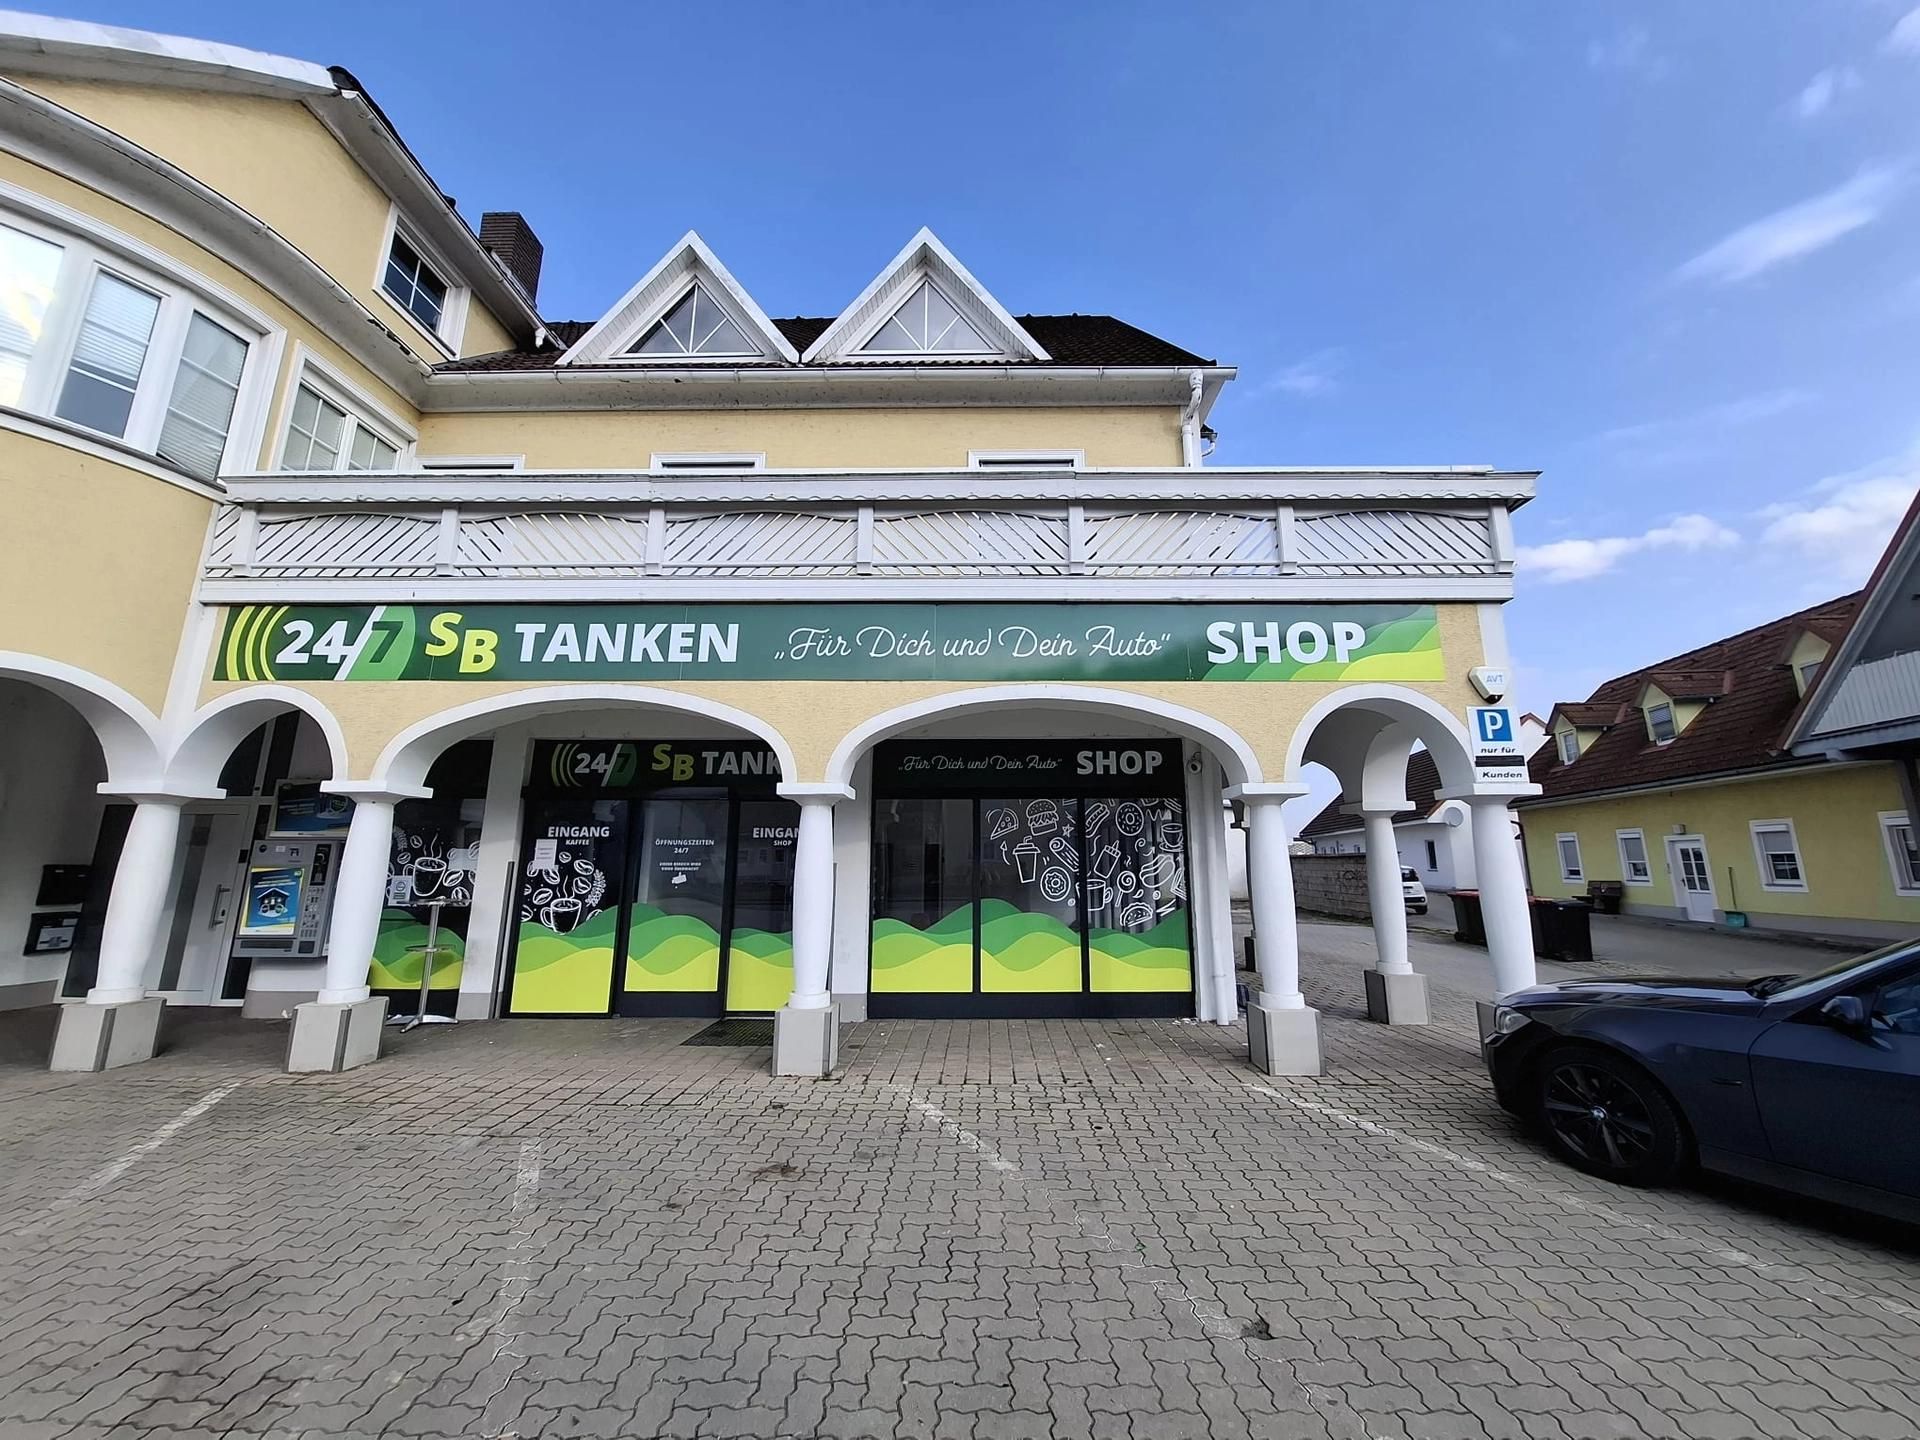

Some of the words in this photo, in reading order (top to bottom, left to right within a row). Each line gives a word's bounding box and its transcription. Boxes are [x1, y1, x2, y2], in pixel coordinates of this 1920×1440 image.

[275, 606, 403, 680] 24/7
[425, 612, 498, 673] SB
[515, 623, 739, 663] TANKEN
[856, 626, 936, 657] Dich
[943, 628, 992, 656] und
[998, 626, 1077, 657] Dein
[1207, 621, 1366, 664] SHOP
[1484, 711, 1503, 739] P
[574, 744, 632, 786] 24/7
[652, 744, 694, 781] SB
[702, 751, 782, 774] TANK
[931, 755, 964, 770] Dich
[968, 757, 988, 769] und
[990, 755, 1023, 770] Dein
[1077, 750, 1162, 775] SHOP
[547, 826, 610, 838] EINGANG
